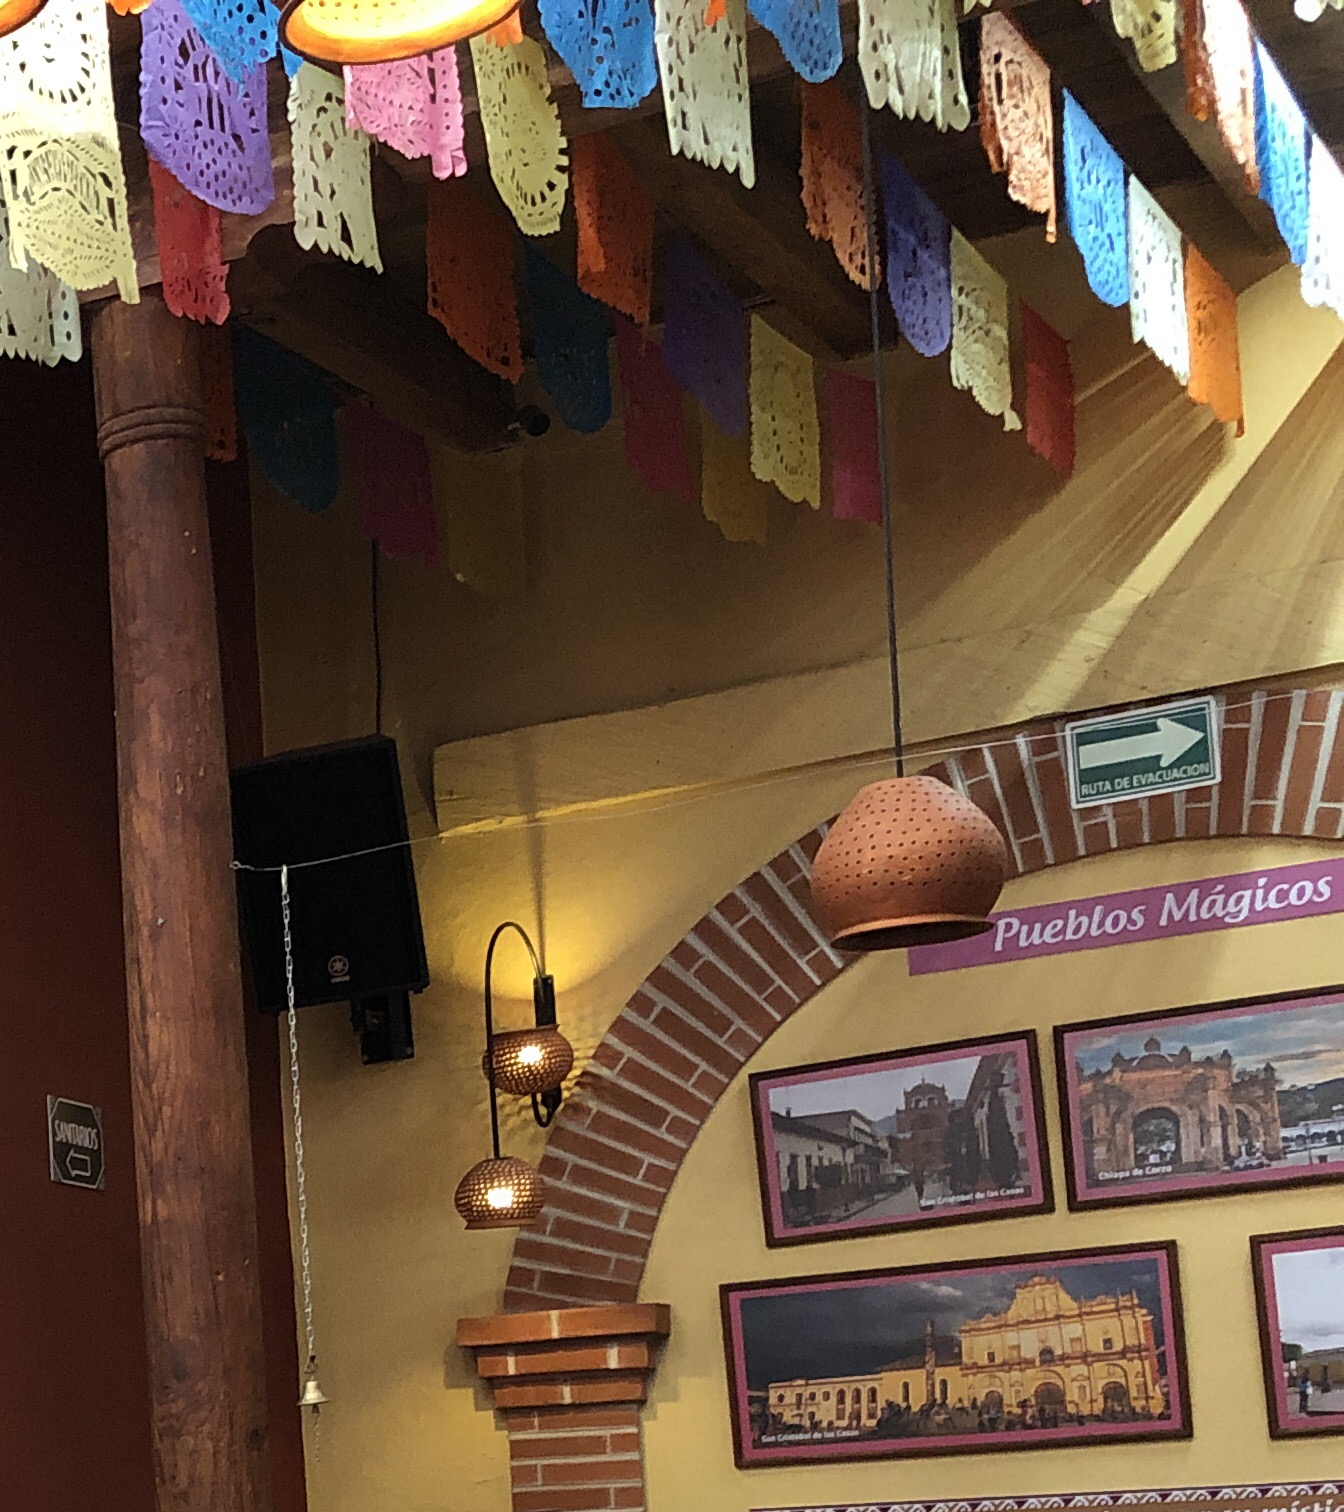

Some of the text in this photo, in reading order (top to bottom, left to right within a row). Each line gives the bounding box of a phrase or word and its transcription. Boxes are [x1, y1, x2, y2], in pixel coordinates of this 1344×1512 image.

[1081, 780, 1112, 796] RUTA
[1114, 776, 1131, 790] DE
[994, 875, 1334, 952] Pueblos Mágicos
[54, 1119, 99, 1150] SANITARIOS
